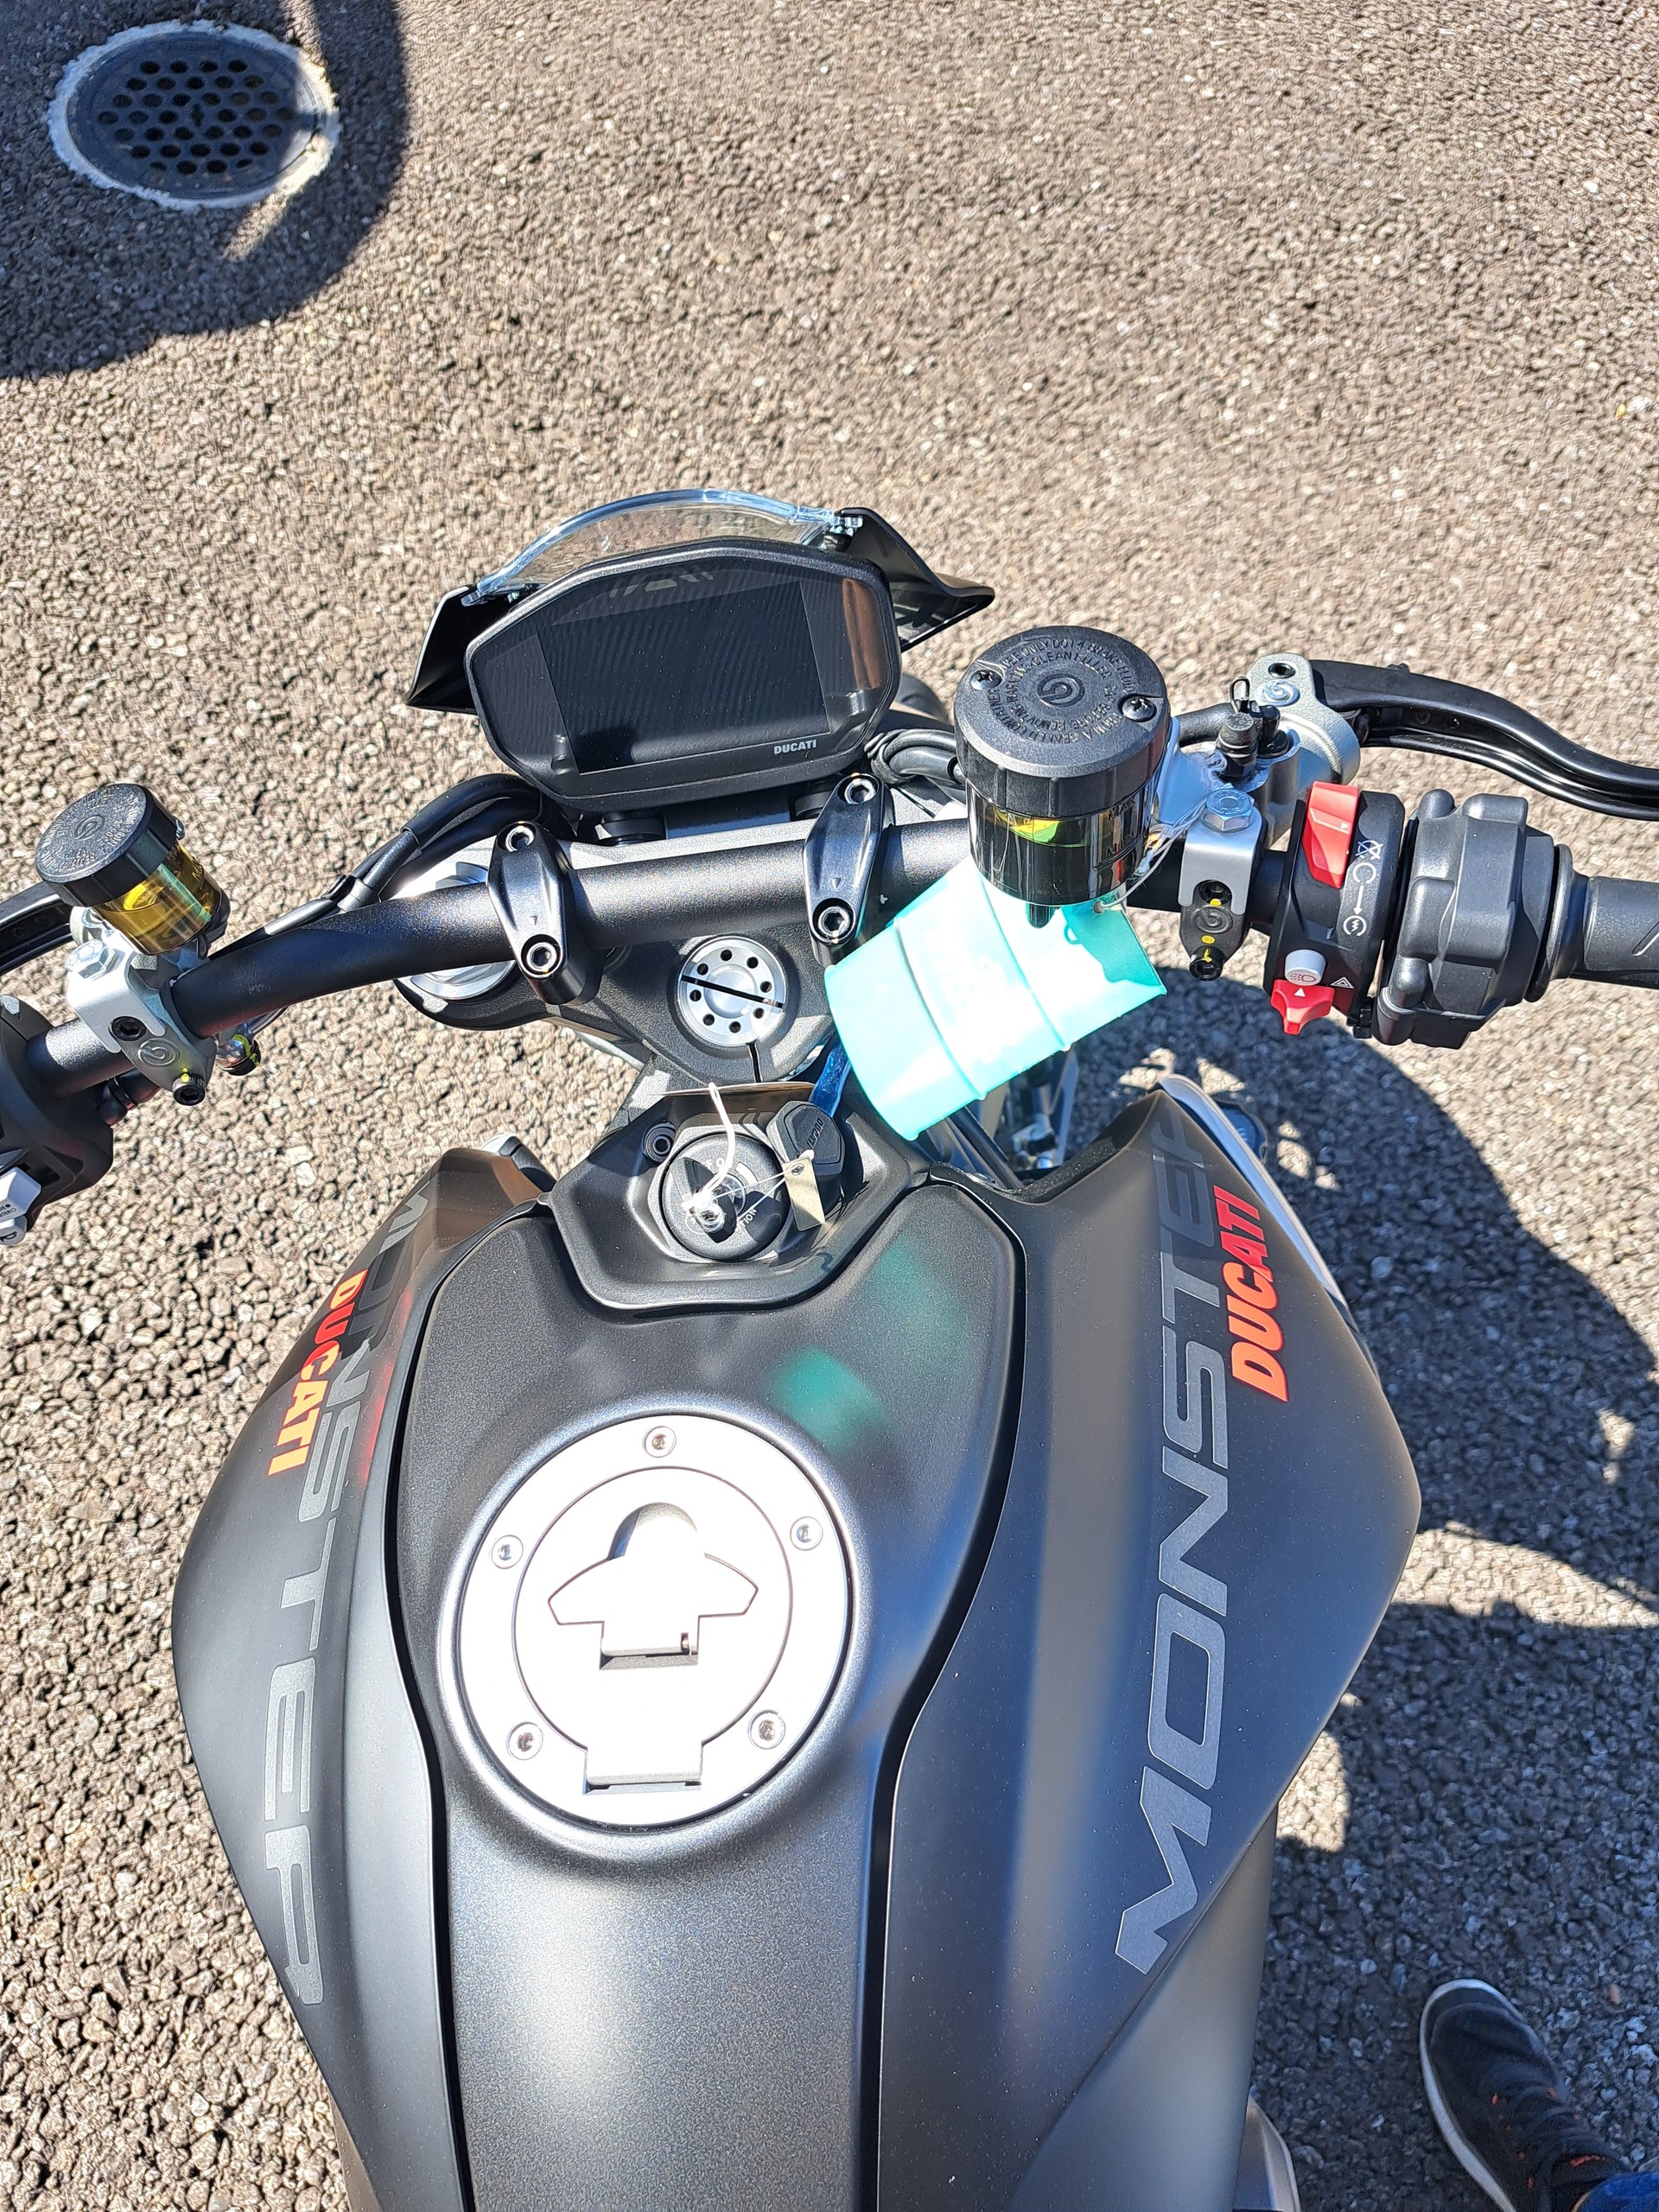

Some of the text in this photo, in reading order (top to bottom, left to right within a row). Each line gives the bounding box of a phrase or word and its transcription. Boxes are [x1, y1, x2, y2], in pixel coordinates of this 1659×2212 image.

[1021, 639, 1050, 657] ONLY
[1032, 651, 1072, 667] CLEAN
[1087, 642, 1123, 667] BRAKE
[1074, 653, 1113, 680] FILLER
[1116, 663, 1136, 692] FLUID
[988, 689, 1027, 738] CONTAINER
[1070, 702, 1111, 731] BEFORE
[773, 739, 817, 755] DUCATI
[1213, 1184, 1288, 1403] DUCATI
[267, 1268, 369, 1476] DUCATI
[1115, 1104, 1230, 1975] MONSTER
[264, 1180, 430, 2005] MONSTER
